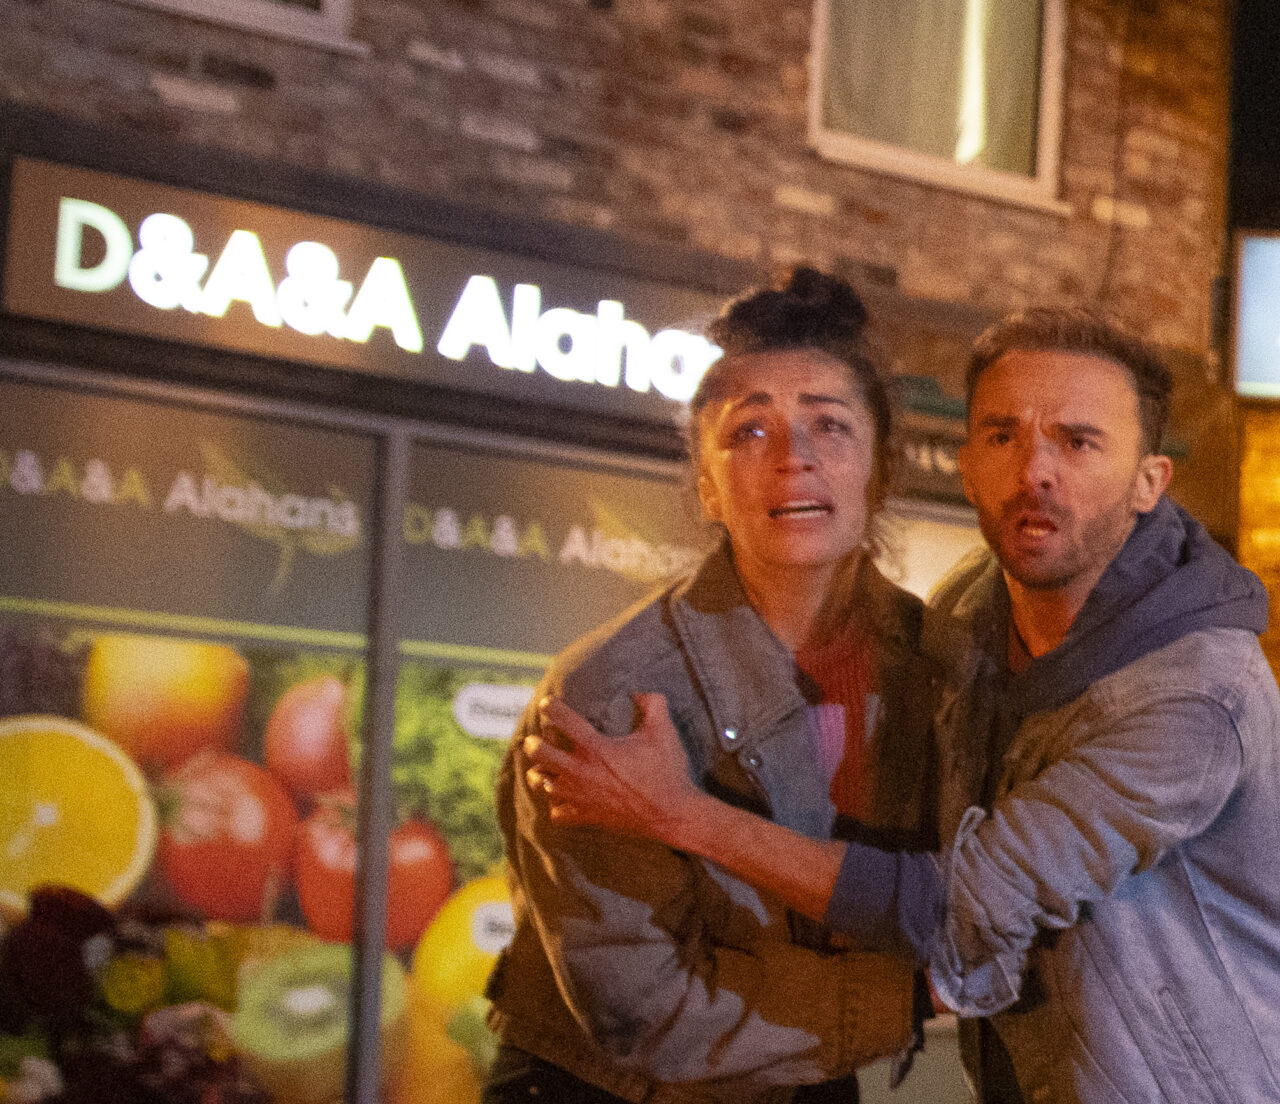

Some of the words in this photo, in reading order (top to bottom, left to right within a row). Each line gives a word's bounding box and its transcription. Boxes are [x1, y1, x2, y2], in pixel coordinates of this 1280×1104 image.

[54, 196, 424, 354] D&A&A
[436, 274, 725, 402] Alaha
[0, 448, 151, 509] &A&A
